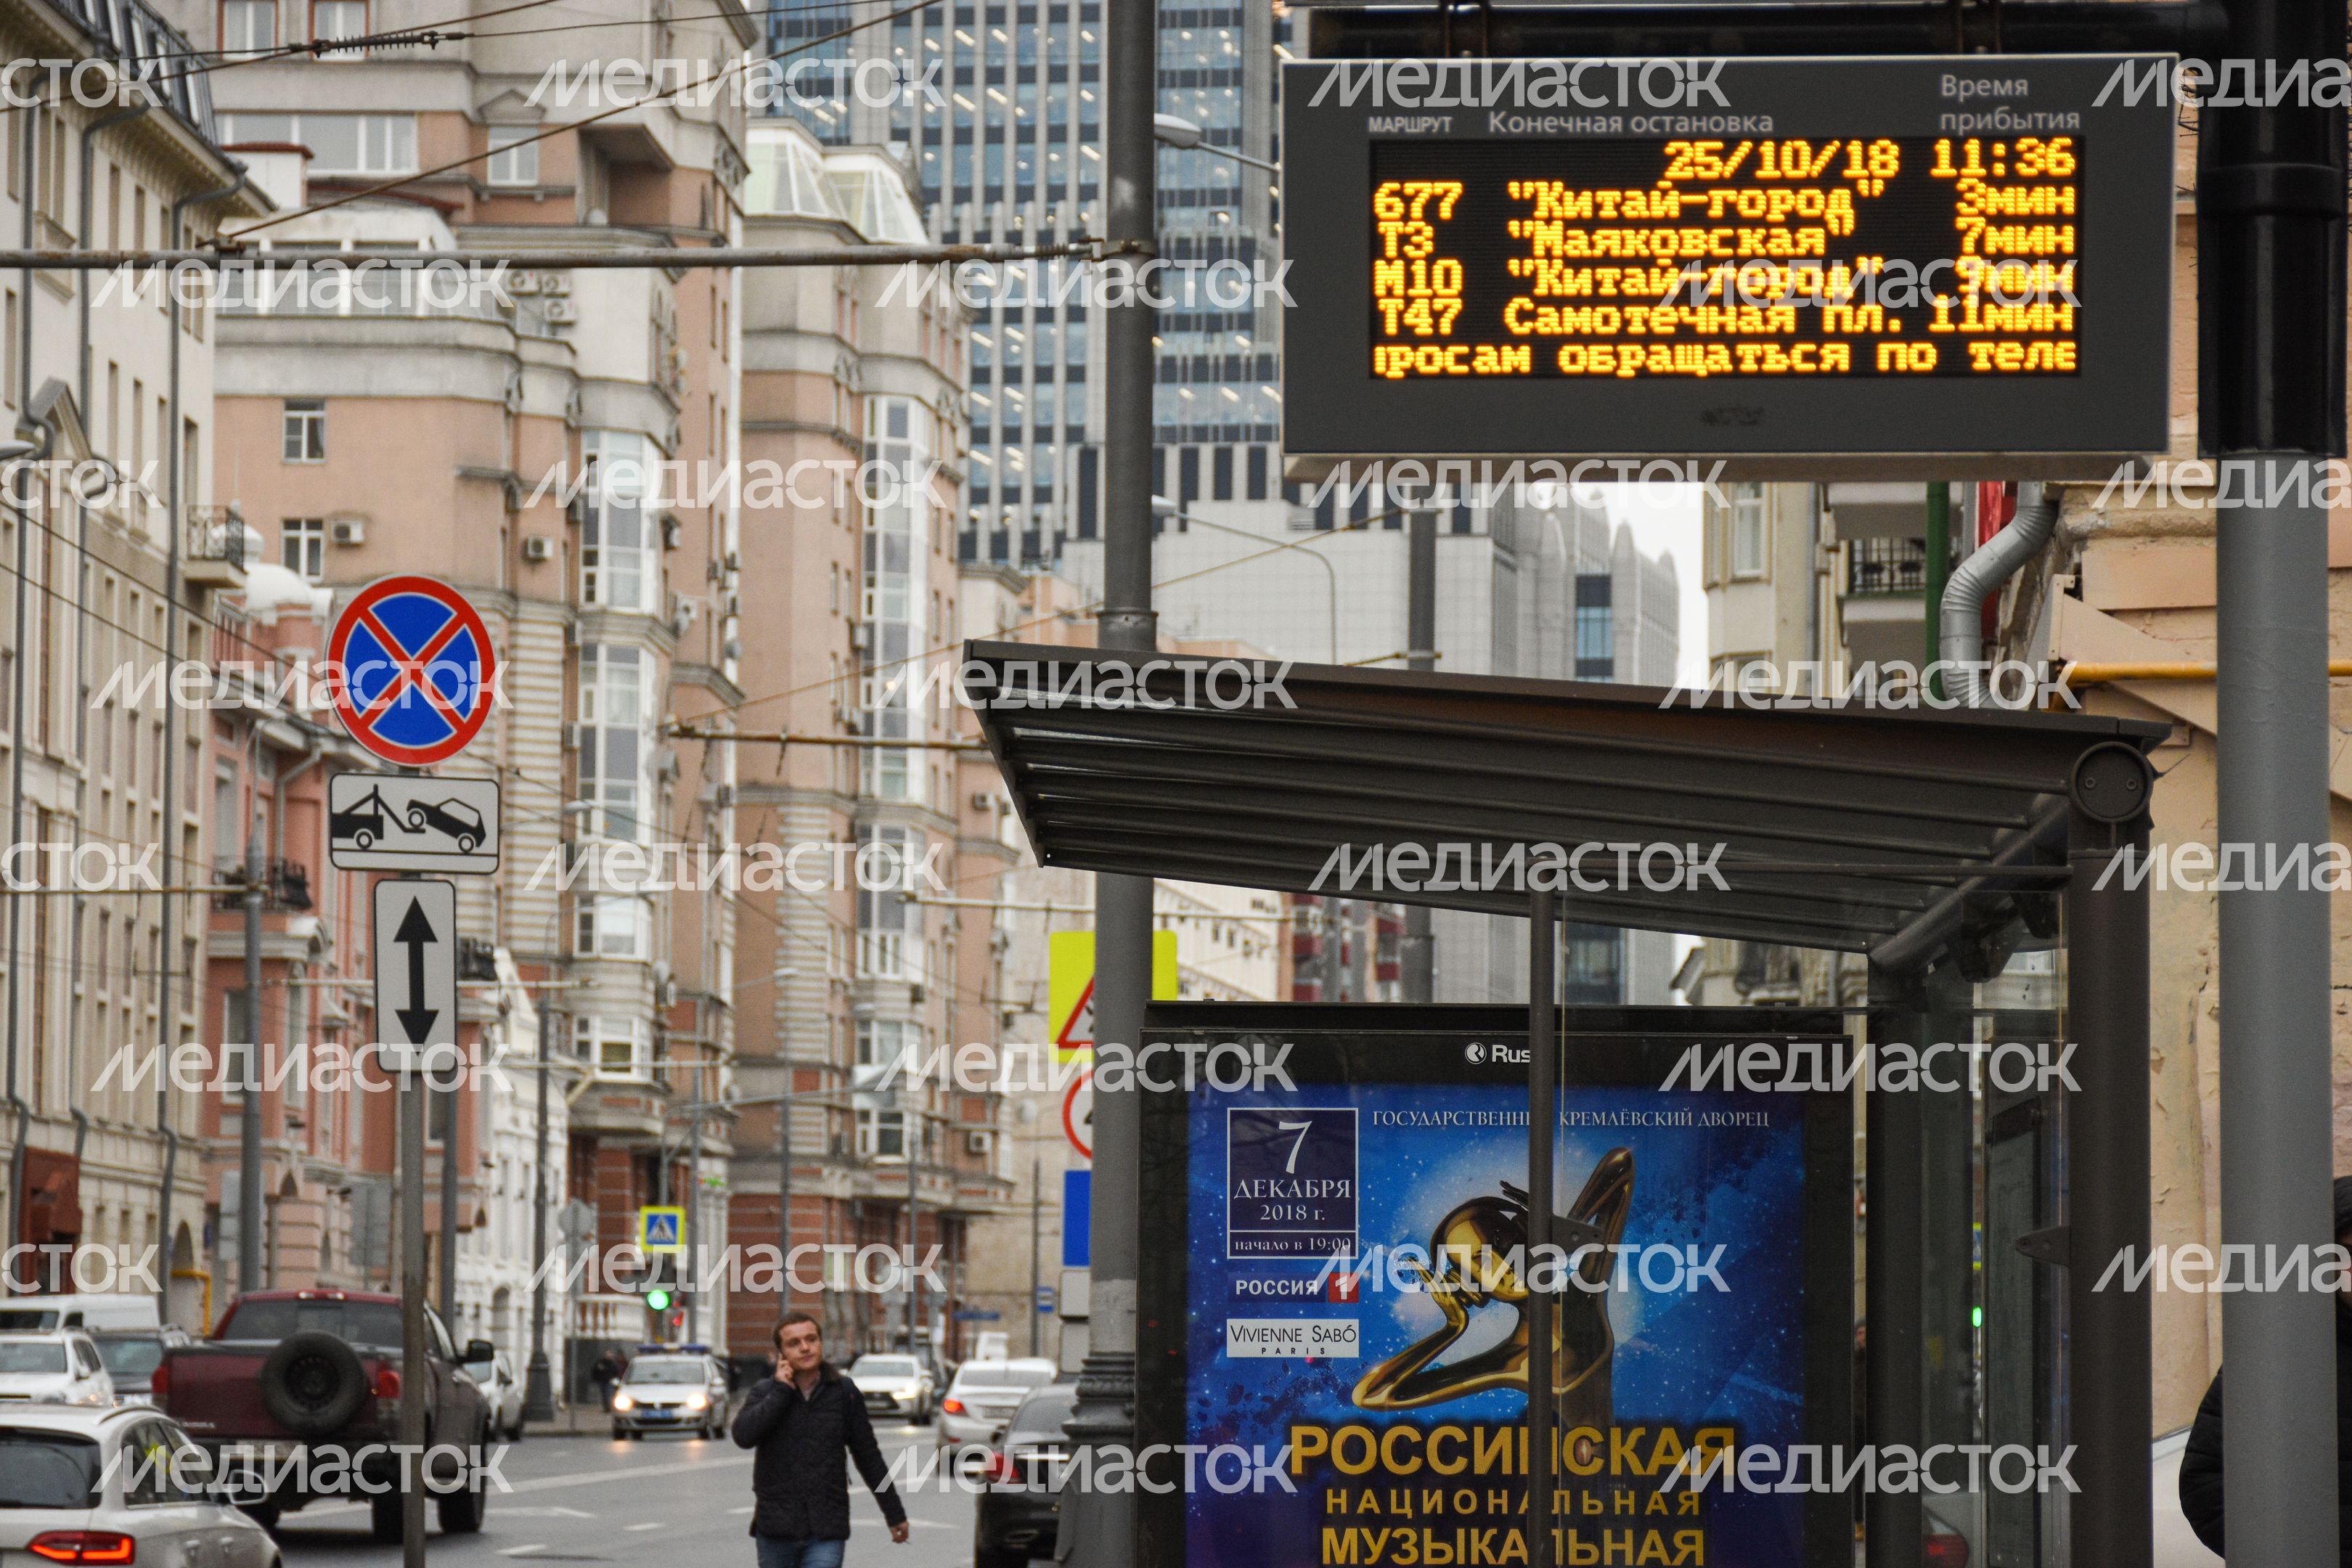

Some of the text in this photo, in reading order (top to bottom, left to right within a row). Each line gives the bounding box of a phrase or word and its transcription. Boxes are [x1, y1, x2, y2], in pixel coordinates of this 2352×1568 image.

[1941, 74, 2029, 102] Время
[1368, 116, 1453, 133] МАРШРУТ
[1490, 112, 1774, 133] Конечная остановка
[1940, 107, 2081, 135] прибытия
[1665, 138, 2076, 179] 25/10/18 11:36
[1374, 181, 1463, 220] 677
[1956, 177, 2075, 216] 3мин
[1377, 221, 1434, 258] Т3
[1955, 216, 2075, 255] 7мин
[1374, 259, 1463, 297] М10
[1377, 298, 1463, 336] Т47
[1503, 297, 1796, 335] Самотечная
[1822, 304, 1902, 333] пл.
[1557, 344, 1850, 377] обращаться
[1877, 343, 1938, 371] по
[1559, 1106, 1693, 1127] КРЕМЛЁВСКИЙ
[1697, 1111, 1770, 1129] ДВОРЕЦ
[1278, 1120, 1312, 1174] 7
[1234, 1179, 1352, 1199] ДЕКАБРЯ
[1260, 1204, 1326, 1221] 2018 г.
[1234, 1237, 1352, 1251] начало в 19:00
[1236, 1275, 1348, 1299] РОССИЯ 1
[1261, 1347, 1326, 1355] PARIS
